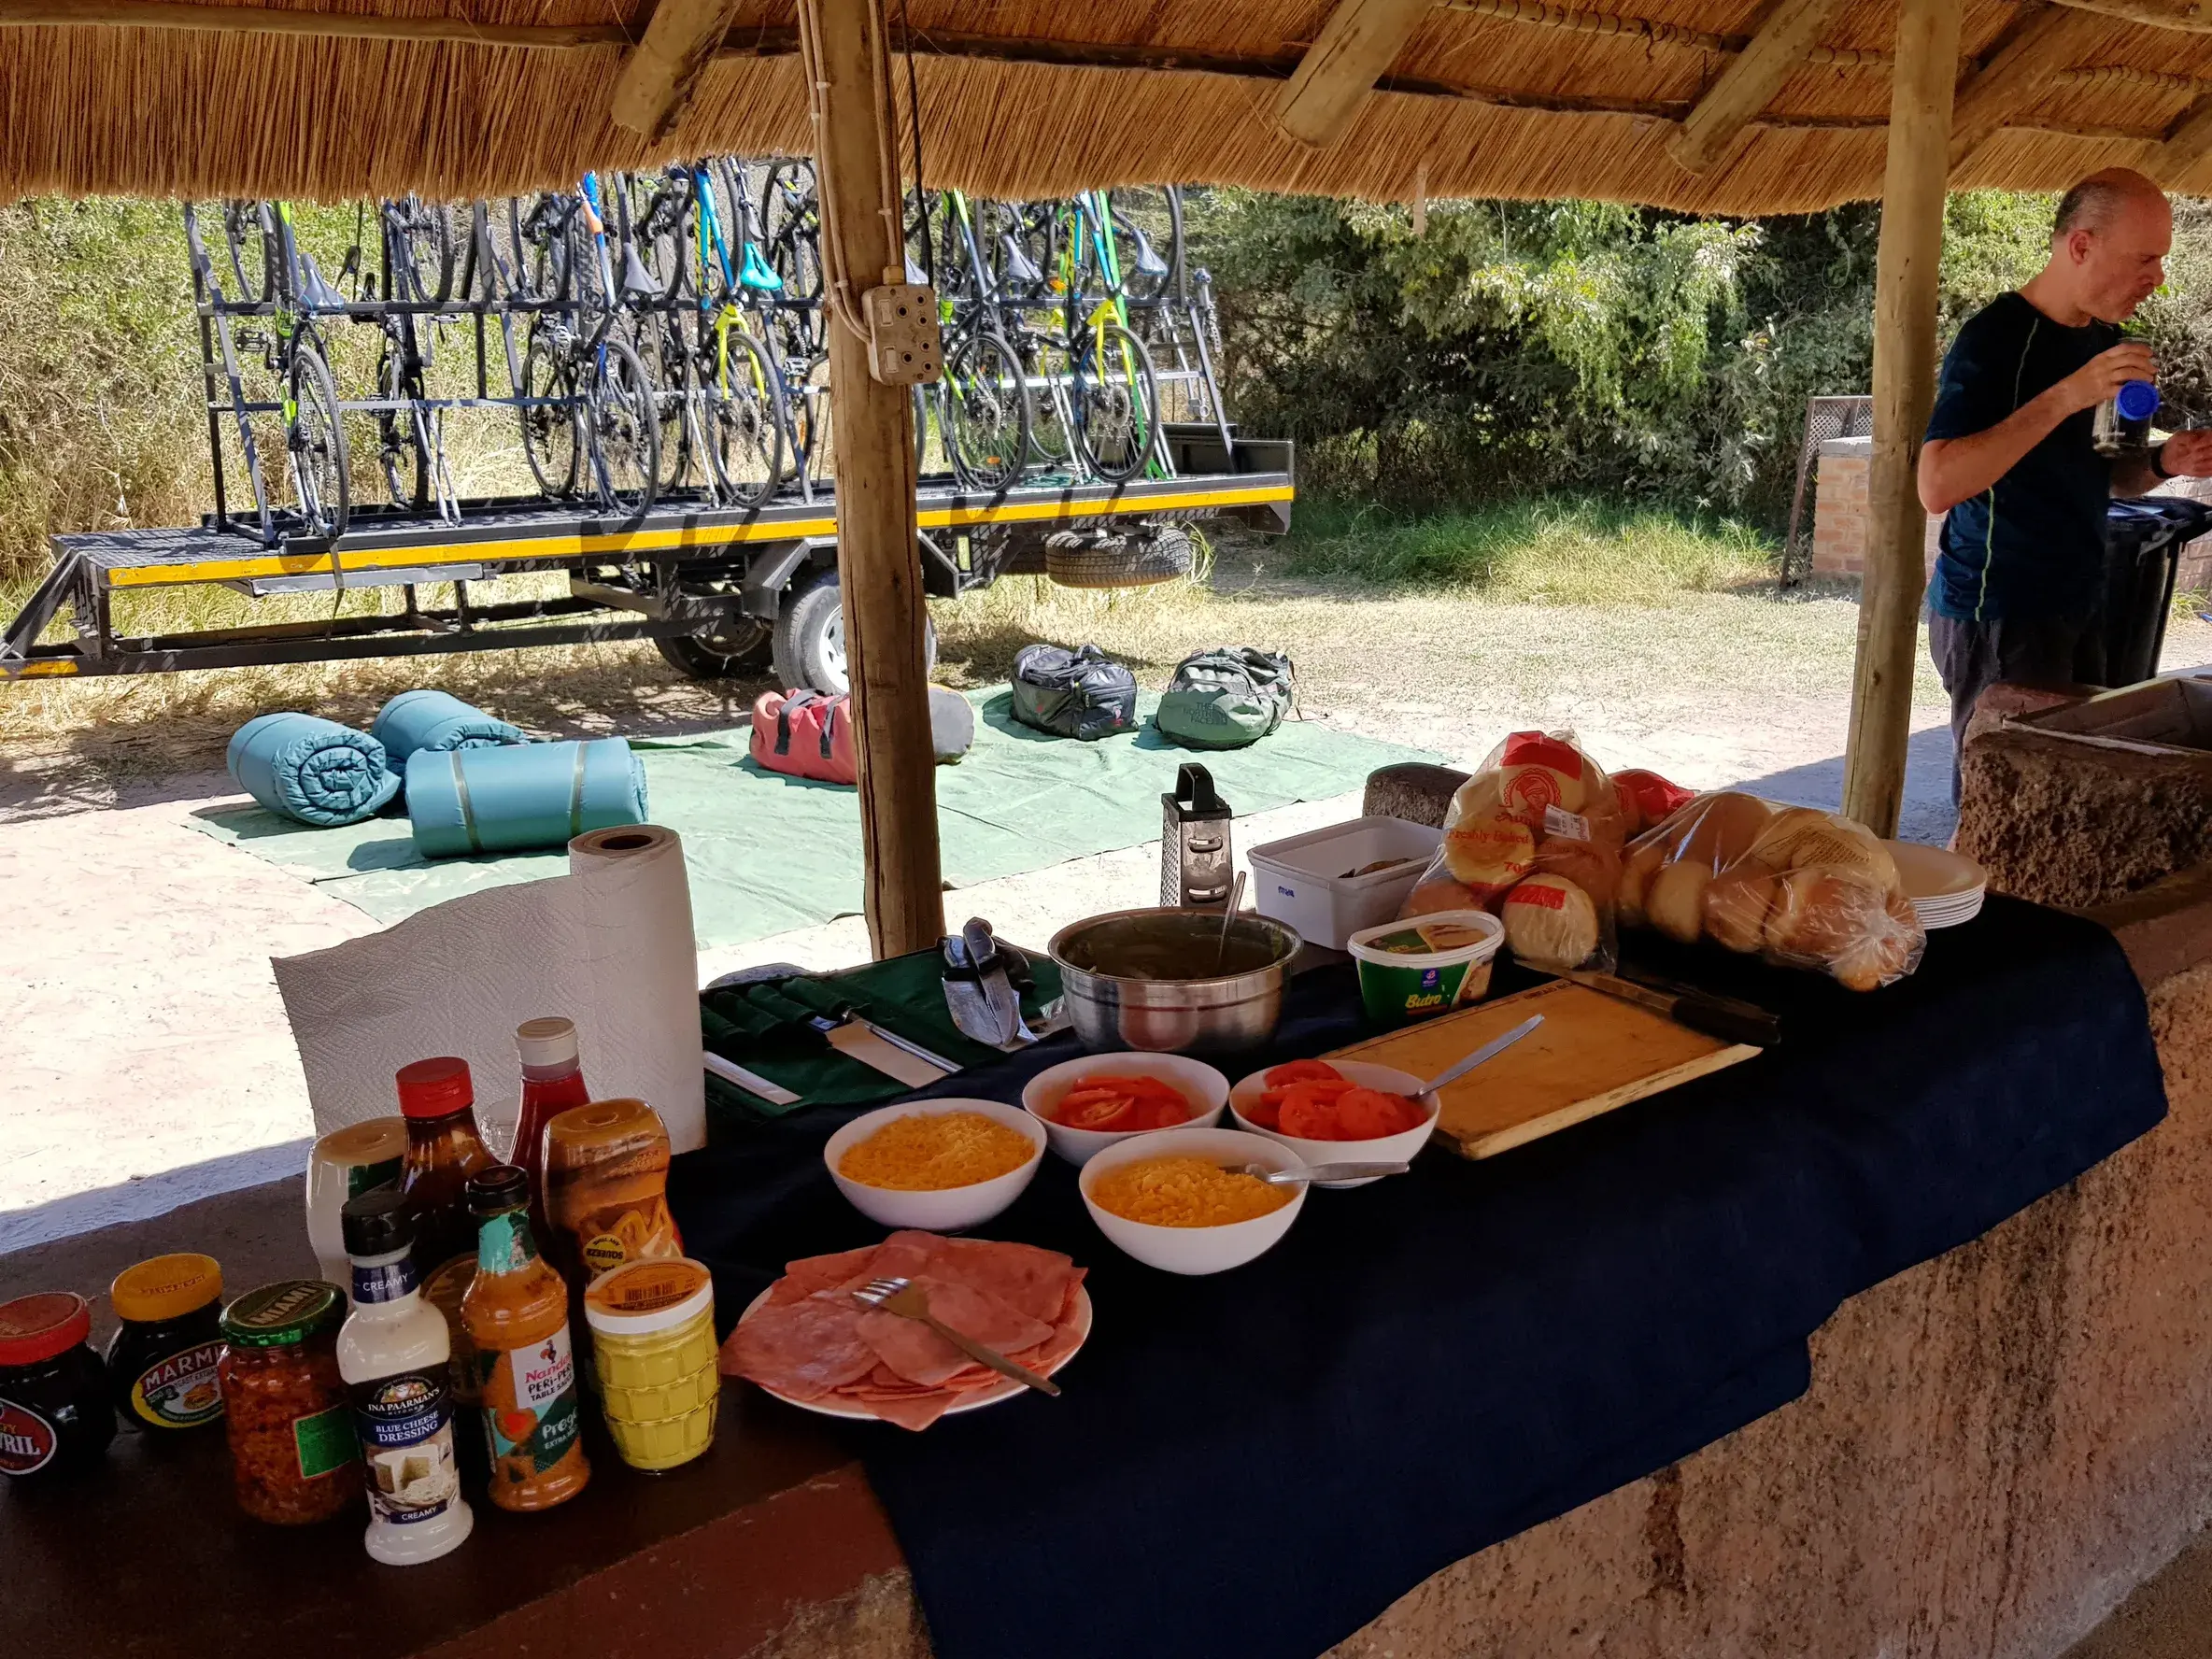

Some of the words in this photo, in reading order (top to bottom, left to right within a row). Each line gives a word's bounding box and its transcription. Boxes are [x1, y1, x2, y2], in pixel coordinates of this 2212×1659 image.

[363, 1273, 408, 1291] CREAMY
[249, 1286, 318, 1325] MIAMI
[531, 1389, 556, 1401] TABLE
[376, 1425, 401, 1433] BLUE
[403, 1411, 438, 1431] CHEESE
[379, 1420, 438, 1442] DRESSING
[402, 1507, 437, 1521] CREAMY
